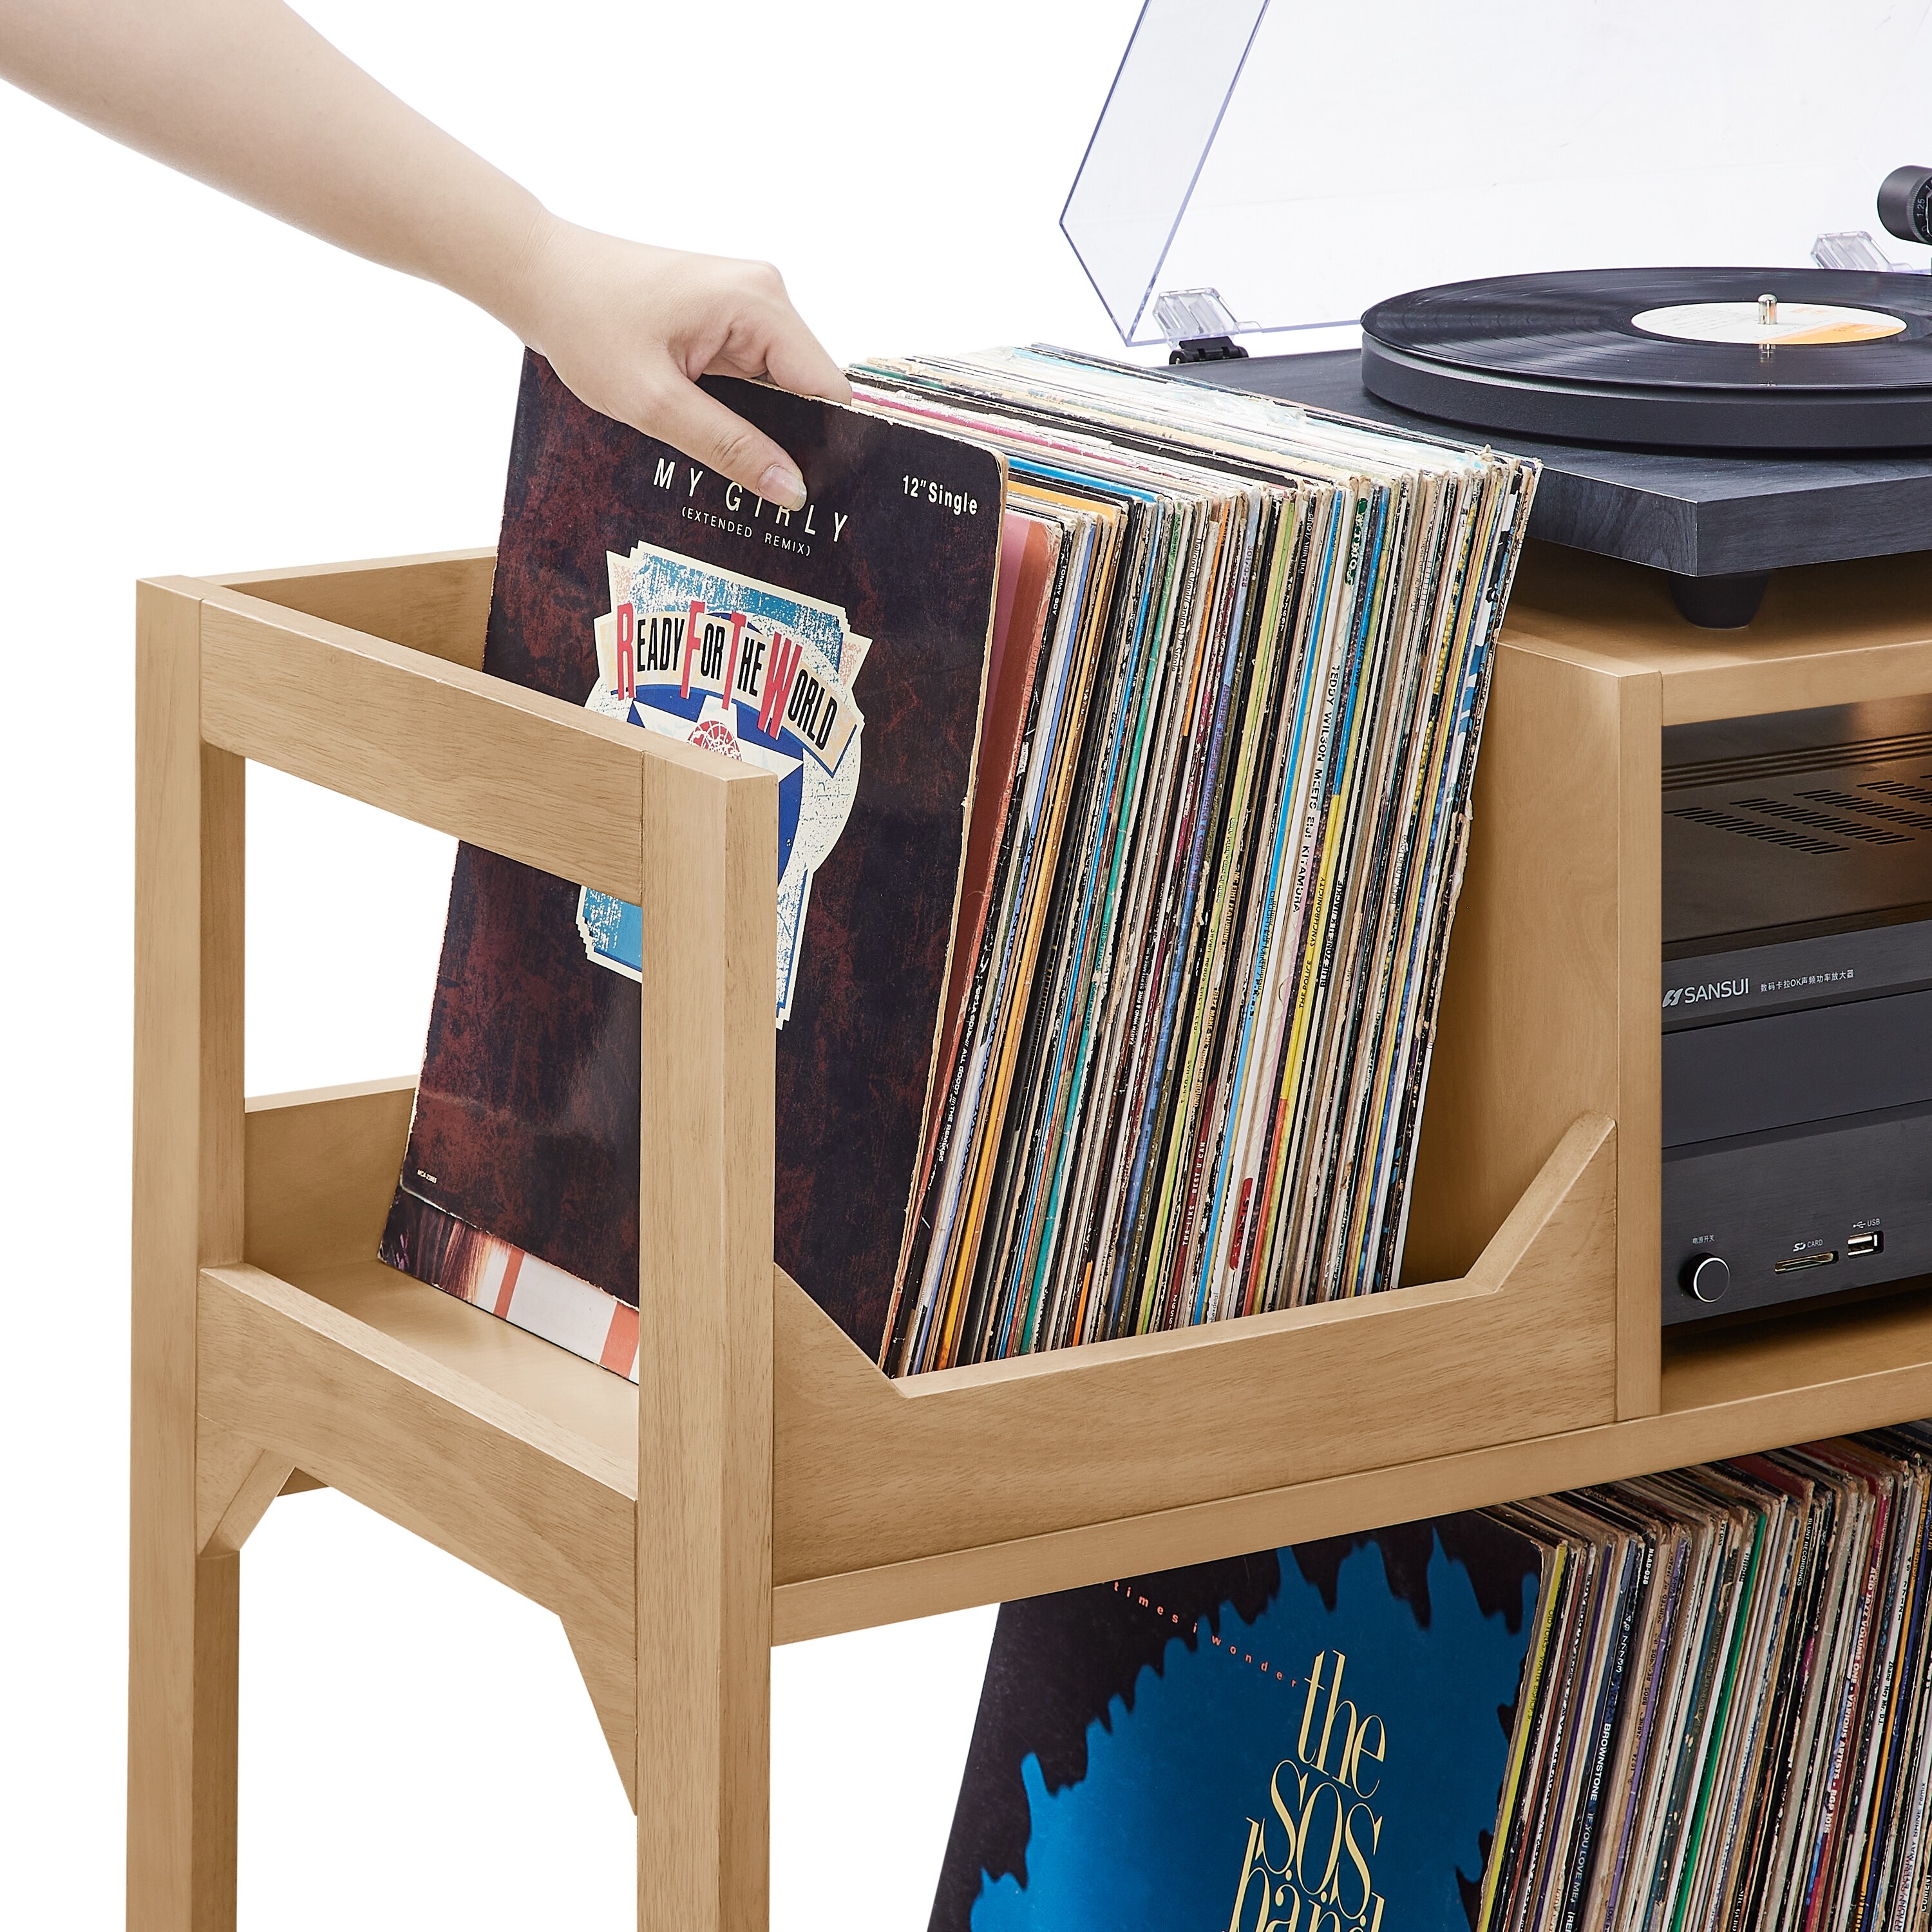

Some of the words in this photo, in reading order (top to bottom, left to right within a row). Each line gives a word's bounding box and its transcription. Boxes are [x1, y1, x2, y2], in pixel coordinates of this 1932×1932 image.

[653, 457, 703, 497] MY
[928, 482, 978, 515] Single
[681, 506, 752, 538] (EXTENDED
[764, 533, 811, 556] REMIX)
[1056, 564, 1066, 595] TOMMY
[1051, 597, 1059, 616] BOY
[617, 602, 685, 701] READY
[680, 600, 726, 699] FOR
[721, 611, 766, 711] THE
[757, 631, 838, 751] WORLD
[1325, 664, 1340, 706] TEDDY
[1316, 711, 1332, 762] WILSON
[1309, 768, 1323, 810] MEETS
[1304, 816, 1314, 838] EIJI
[1292, 845, 1309, 913] KITAMURA
[1302, 960, 1311, 990] POLICE
[1309, 876, 1325, 947] SYNCHRONICITY
[1324, 936, 1334, 961] ZONE
[1320, 963, 1329, 988] BLUE
[1685, 978, 1749, 1003] SANSUI
[959, 1048, 967, 1064] ALL
[952, 1065, 964, 1095] GOOD?
[1182, 1229, 1190, 1245] THA
[1186, 1204, 1194, 1225] LIKS
[1191, 1171, 1200, 1193] BEST
[1867, 1218, 1880, 1227] USB
[1692, 1235, 1715, 1245] 电源开关
[1807, 1239, 1823, 1248] CARD
[1804, 1518, 1813, 1539] BLUNT
[1796, 1540, 1808, 1587] RECORDINGS
[1867, 1566, 1876, 1590] ACID
[1862, 1592, 1871, 1618] JAZZ
[1896, 1580, 1908, 1621] 77121
[1113, 1581, 1179, 1624] times
[1211, 1635, 1296, 1687] wonder
[1624, 1614, 1631, 1632] 49
[1615, 1634, 1628, 1673] 77733
[1854, 1619, 1868, 1661] VOLUME
[1850, 1662, 1860, 1684] ONE
[1297, 1649, 1386, 1799] the
[1840, 1693, 1854, 1738] VARIOUS
[1589, 1723, 1611, 1801] BROWNSTONE
[1833, 1740, 1845, 1779] ARTISTS
[1827, 1789, 1837, 1811] BGP
[1918, 1782, 1926, 1806] remix
[1582, 1824, 1592, 1849] YOU
[1575, 1850, 1586, 1879] LOVE
